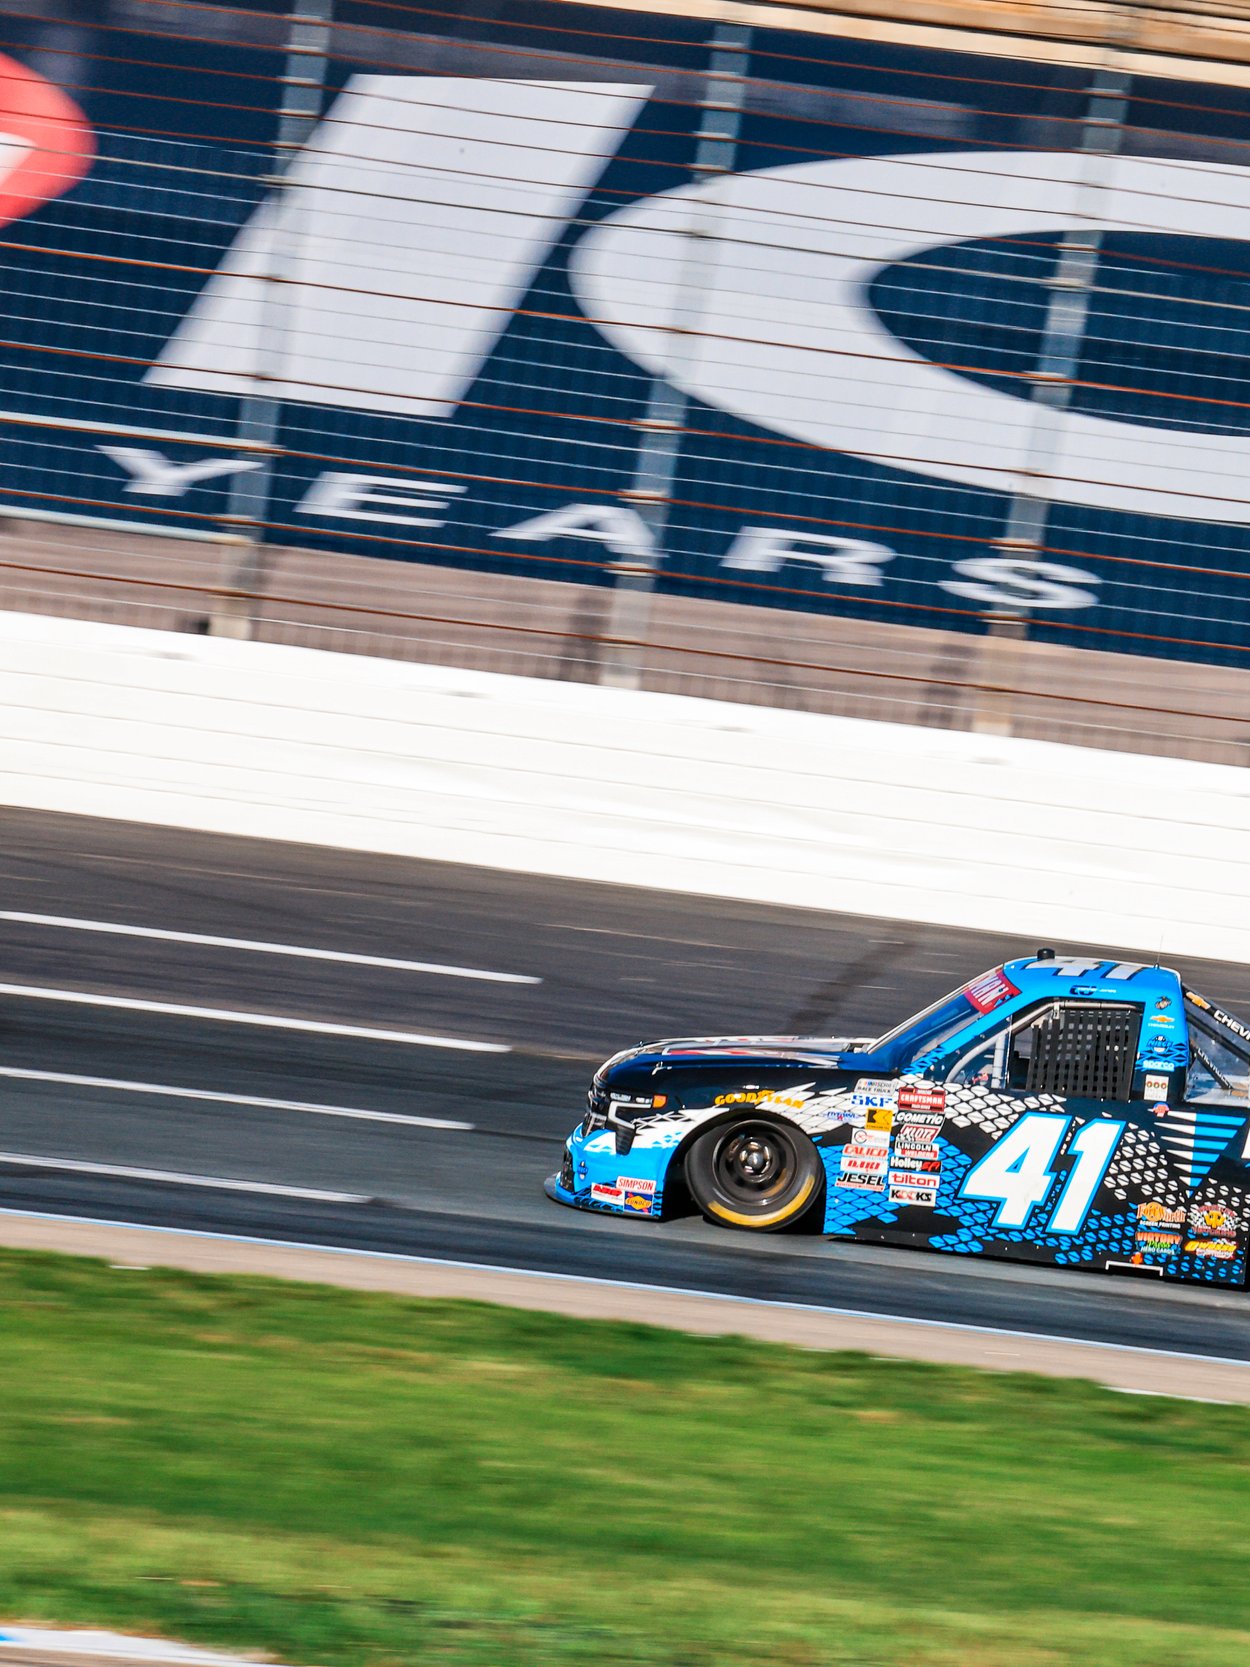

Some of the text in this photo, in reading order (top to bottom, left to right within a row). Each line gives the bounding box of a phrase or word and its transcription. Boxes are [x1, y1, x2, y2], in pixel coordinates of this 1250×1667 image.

[97, 445, 1101, 610] YEARS
[714, 1090, 805, 1109] GOODYEAR
[851, 1094, 893, 1107] SKF
[900, 1094, 943, 1105] CRAFTSMAN
[902, 1126, 937, 1142] KLOTZ
[844, 1146, 888, 1157] CALICO
[896, 1142, 933, 1151] LINCOLN
[890, 1156, 922, 1171] Holley
[837, 1172, 885, 1186] JESEL
[892, 1173, 937, 1187] tilton
[958, 1111, 1125, 1236] 41
[619, 1178, 653, 1191] SIMPSON
